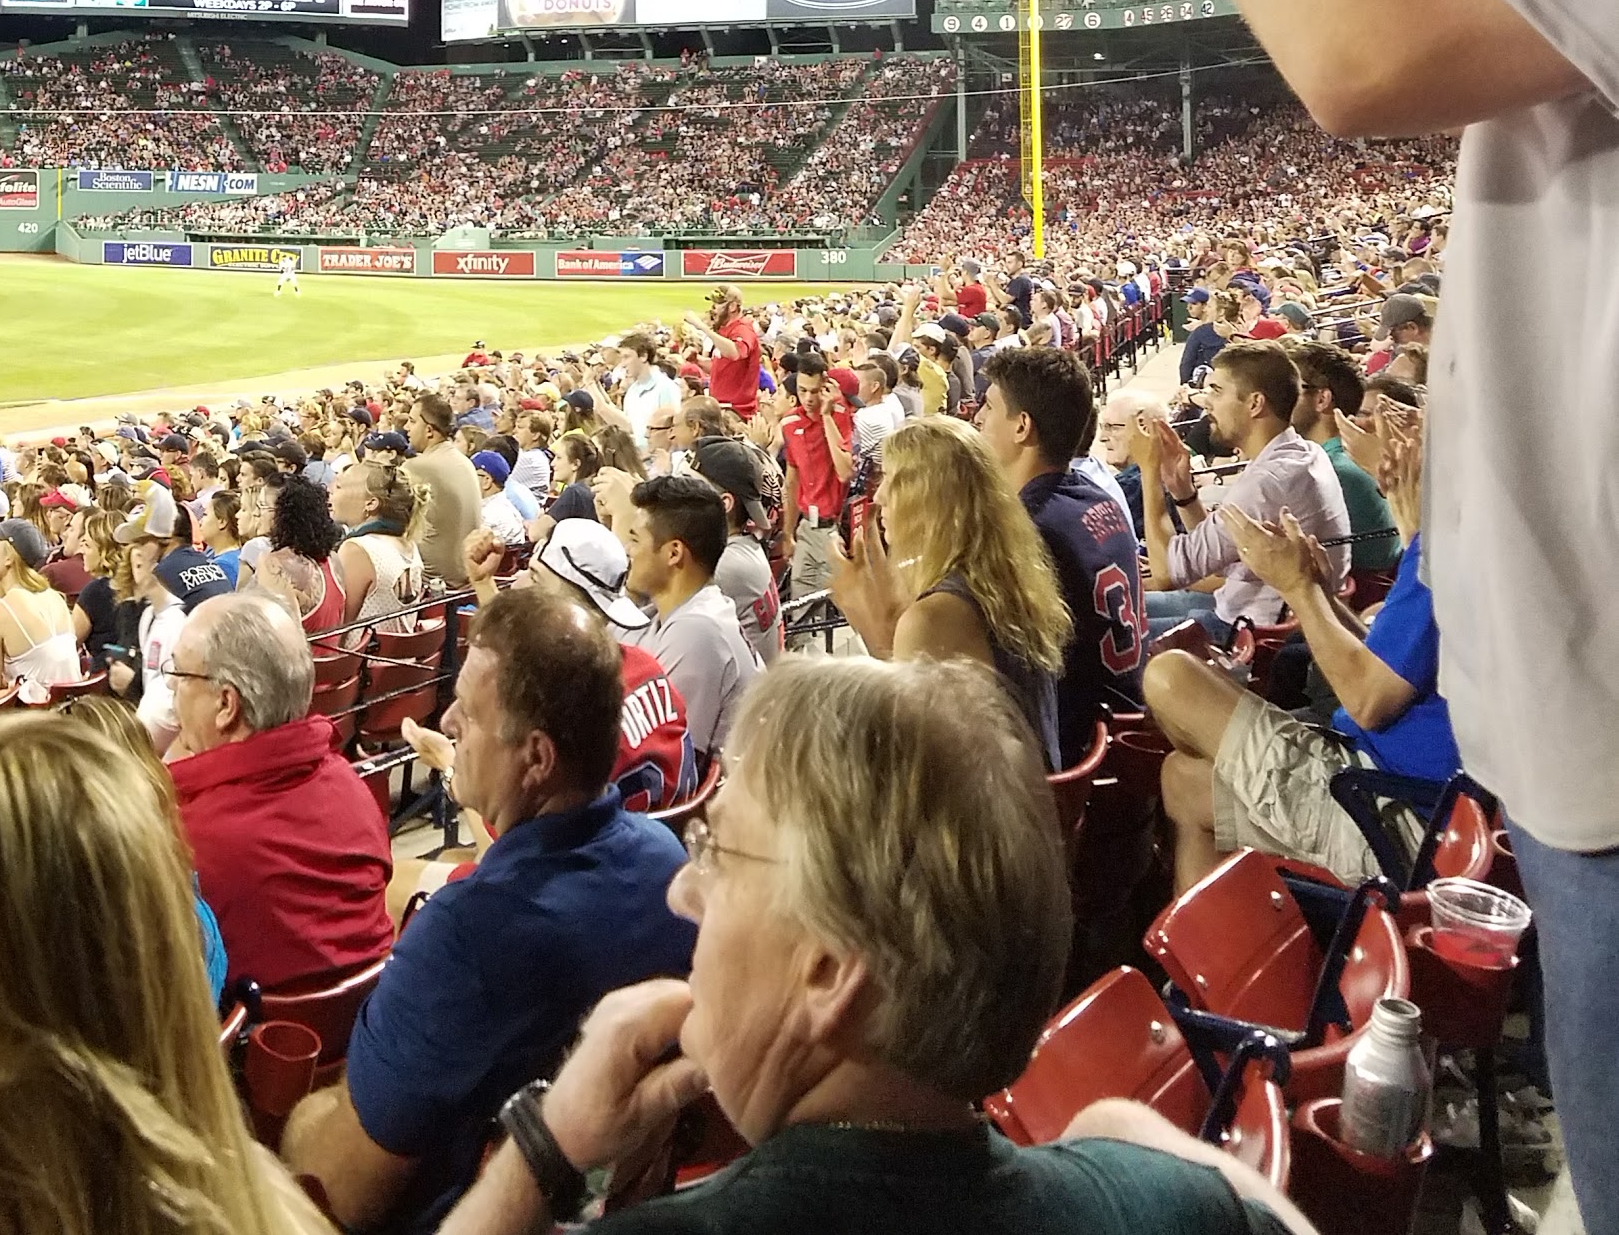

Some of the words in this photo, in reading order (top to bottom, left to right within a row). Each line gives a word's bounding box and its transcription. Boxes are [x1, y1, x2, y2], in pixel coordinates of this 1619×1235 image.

[258, 0, 272, 11] 2P
[100, 173, 131, 182] Boston
[177, 175, 219, 191] NESN
[92, 179, 143, 190] Scientific
[17, 223, 39, 234] 420
[121, 244, 172, 263] jetBlue
[212, 248, 268, 265] GRANITE
[820, 251, 847, 264] 380
[322, 254, 371, 268] TRADER
[374, 255, 412, 269] JOE'S
[456, 254, 510, 274] xfinity
[558, 259, 579, 270] Bank
[580, 259, 593, 270] of
[593, 260, 634, 271] America
